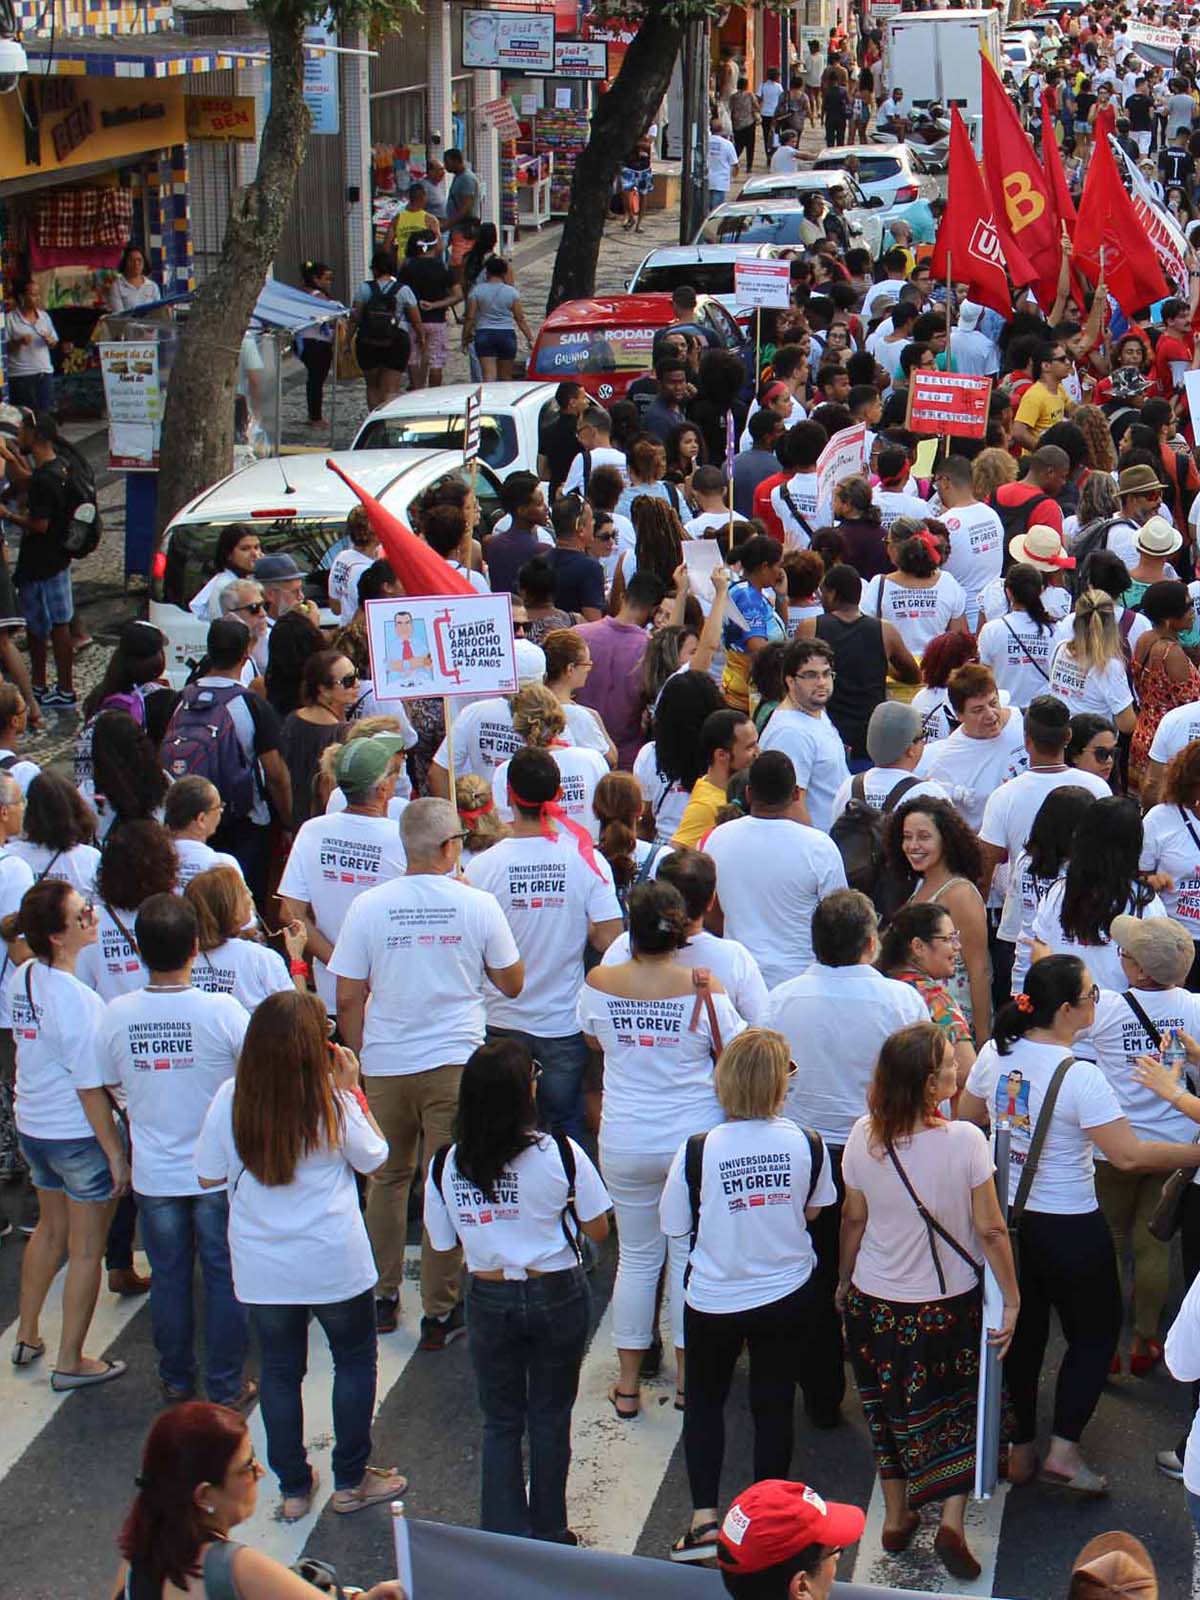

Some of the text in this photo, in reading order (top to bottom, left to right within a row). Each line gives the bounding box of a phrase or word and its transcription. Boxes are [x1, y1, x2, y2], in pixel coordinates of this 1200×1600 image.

[1003, 171, 1045, 235] B
[560, 329, 656, 345] SAIA RODAD
[892, 600, 936, 610] EM GREVE
[448, 622, 495, 640] O MAIOR
[450, 634, 500, 649] ARROCHO
[451, 647, 505, 659] SALARIAL
[1007, 645, 1020, 655] EM
[453, 658, 501, 668] EM 20 ANOS
[1052, 671, 1085, 689] EM GREVE
[479, 738, 494, 749] EM
[322, 837, 382, 853] UNIVERSIDADES
[320, 852, 380, 873] EM GREVE
[508, 863, 567, 874] UNIVERSIDADES
[510, 880, 566, 894] EM GREVE
[104, 947, 120, 958] EM
[606, 1000, 685, 1012] UNIVERSIDADES
[128, 1021, 192, 1033] UNIVERSIDADES
[612, 1017, 681, 1033] EM GREVE
[130, 1039, 193, 1055] EM GREVE
[1123, 1039, 1142, 1051] EM
[719, 1152, 791, 1172] UNIVERSIDADES
[722, 1173, 791, 1195] EM GREVE
